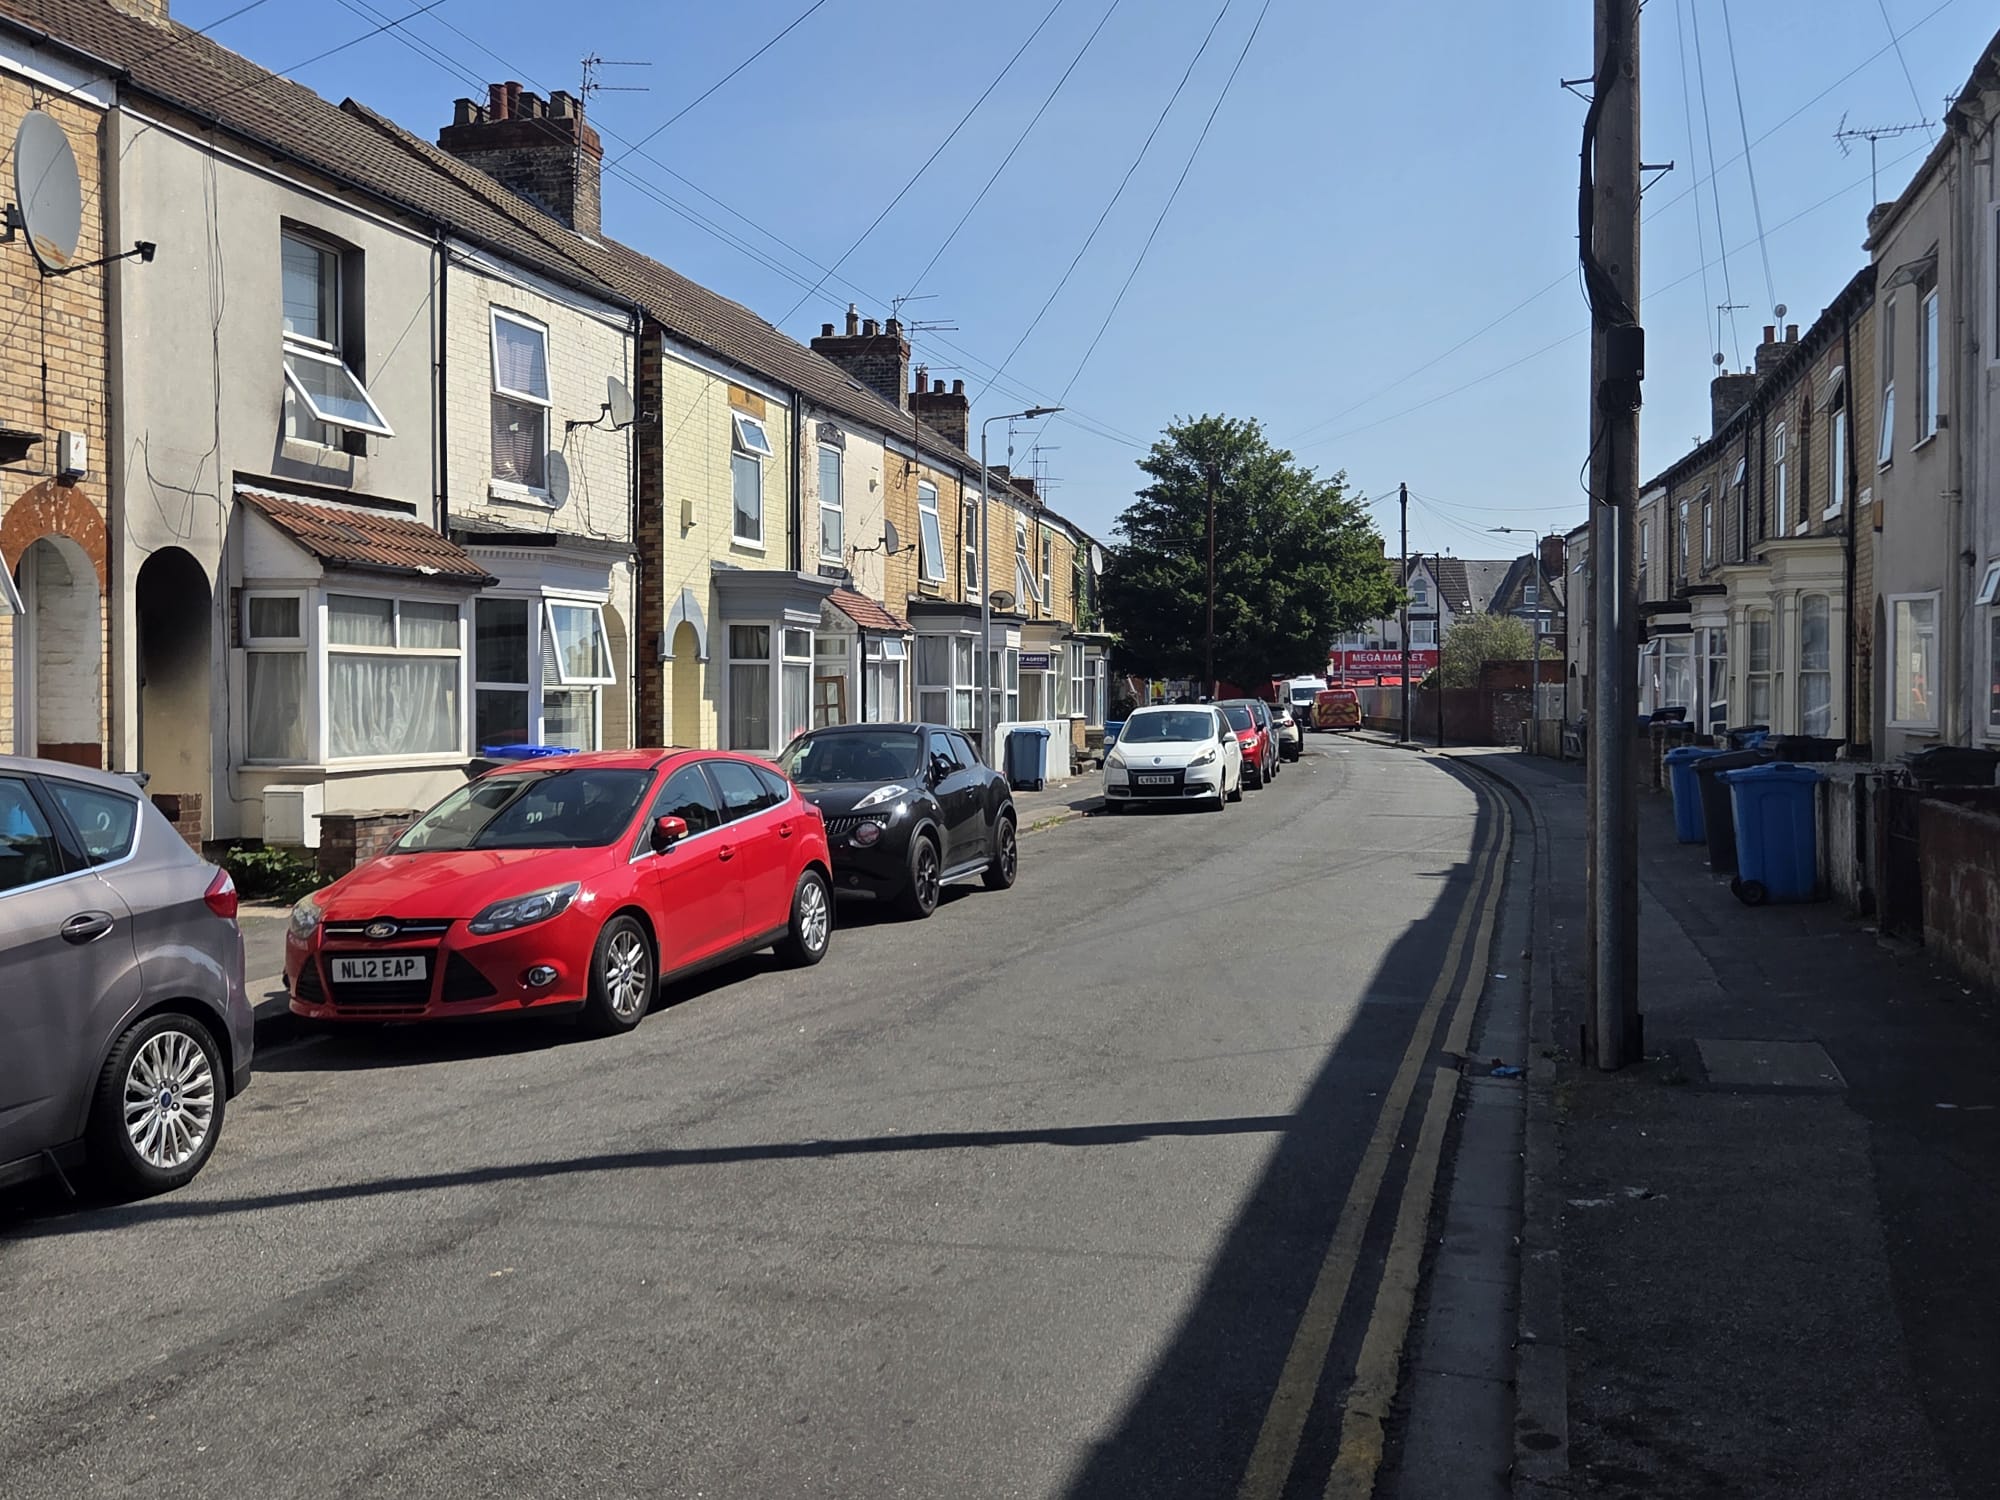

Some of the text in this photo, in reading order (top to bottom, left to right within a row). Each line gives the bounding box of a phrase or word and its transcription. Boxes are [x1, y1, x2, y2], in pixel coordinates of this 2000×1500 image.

[1352, 653, 1424, 662] MEGA MARET
[341, 959, 415, 979] NL12 EAP
